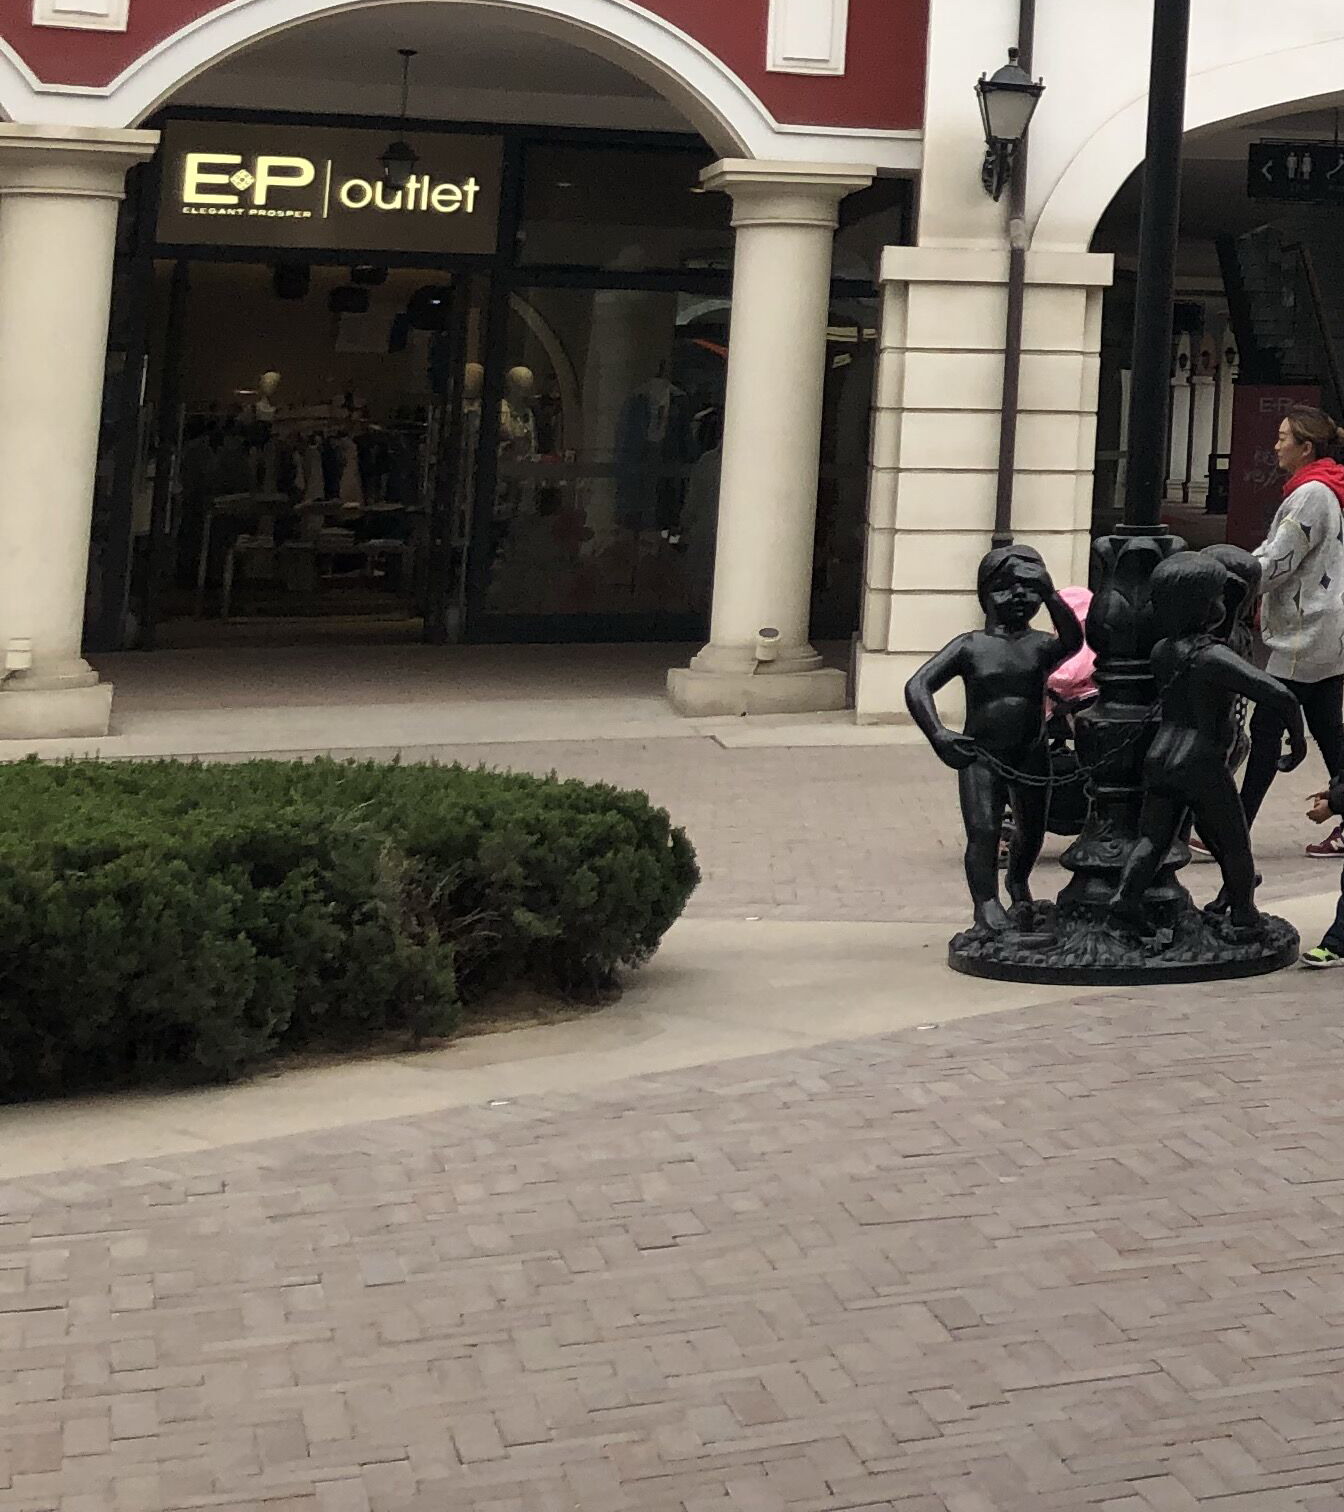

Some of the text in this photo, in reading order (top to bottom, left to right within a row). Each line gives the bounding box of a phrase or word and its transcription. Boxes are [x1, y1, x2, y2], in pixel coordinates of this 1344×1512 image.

[340, 174, 480, 212] outlet
[182, 207, 311, 218] ELEGANT PROSPER
